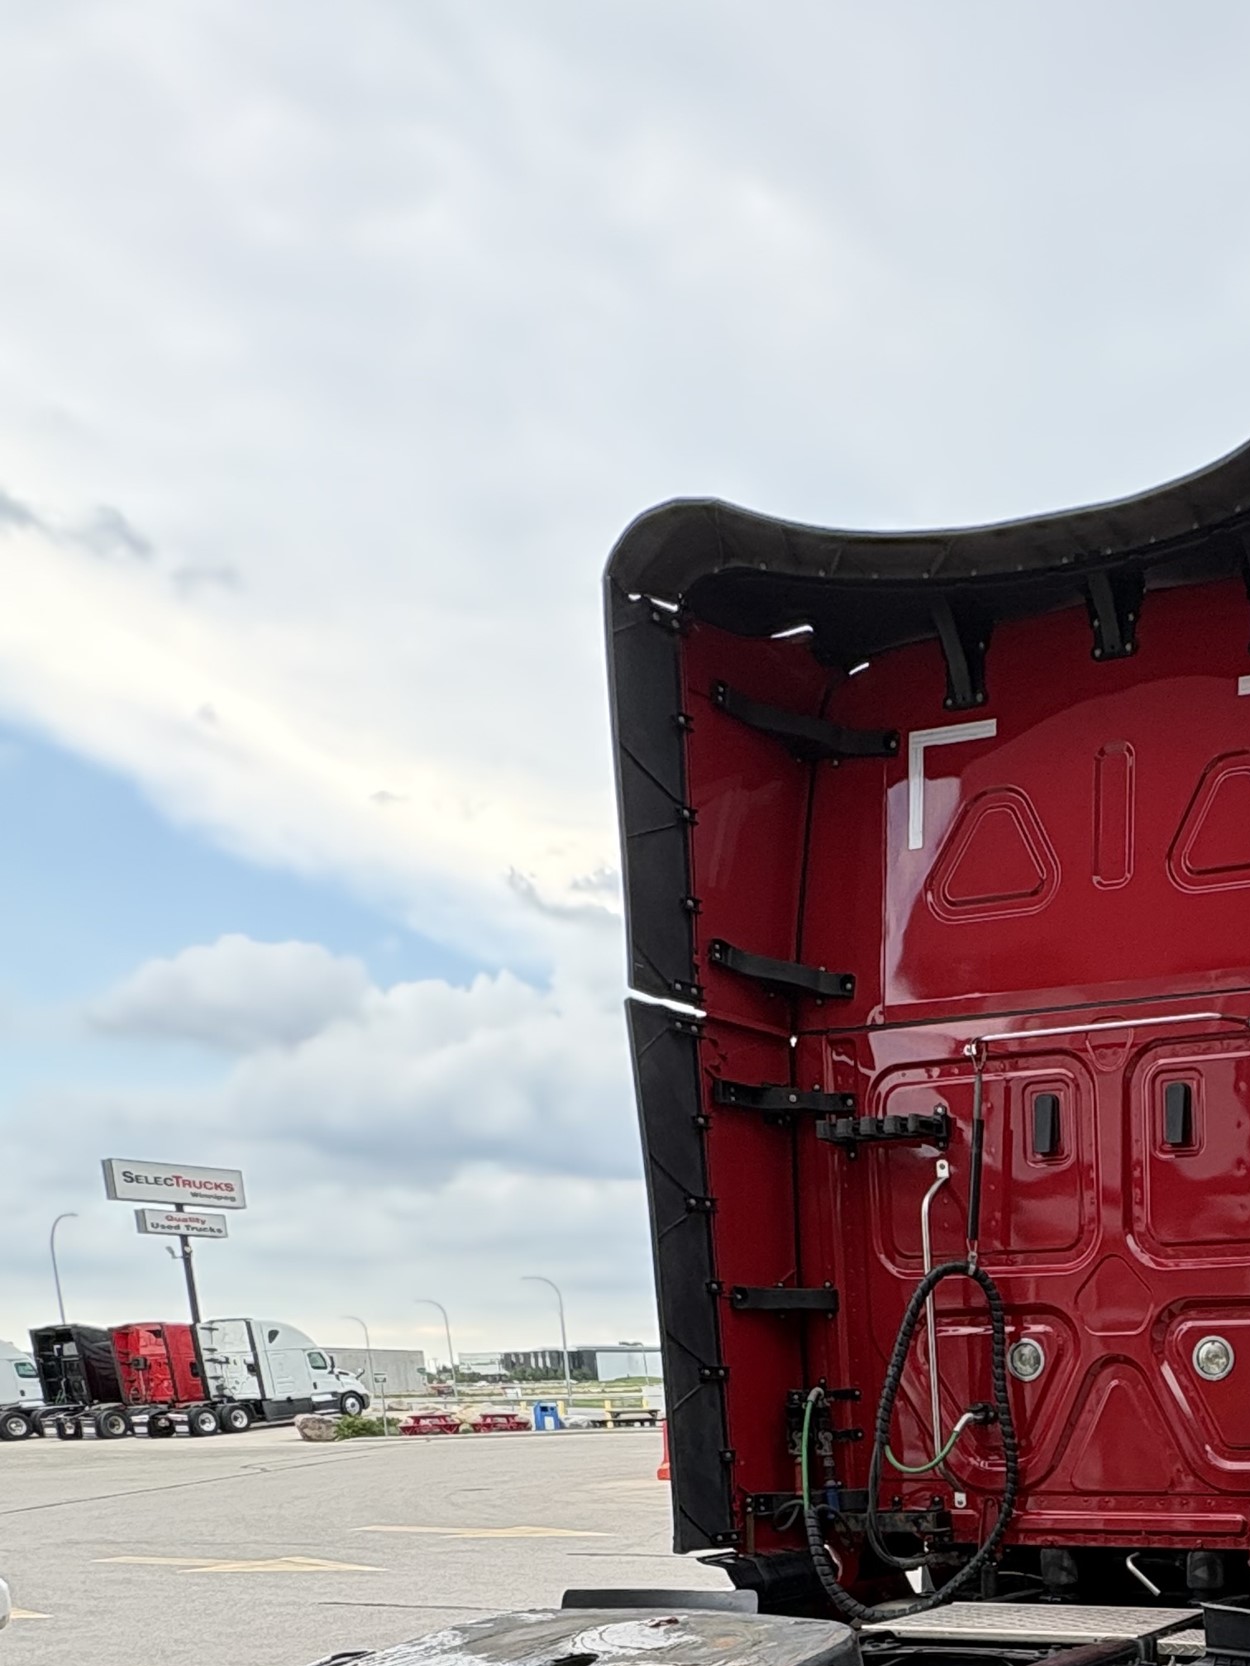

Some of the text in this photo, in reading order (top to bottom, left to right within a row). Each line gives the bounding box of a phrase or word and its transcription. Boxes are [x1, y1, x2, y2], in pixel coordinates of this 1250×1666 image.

[165, 1214, 206, 1225] Quality
[150, 1222, 223, 1234] Used Trucks
